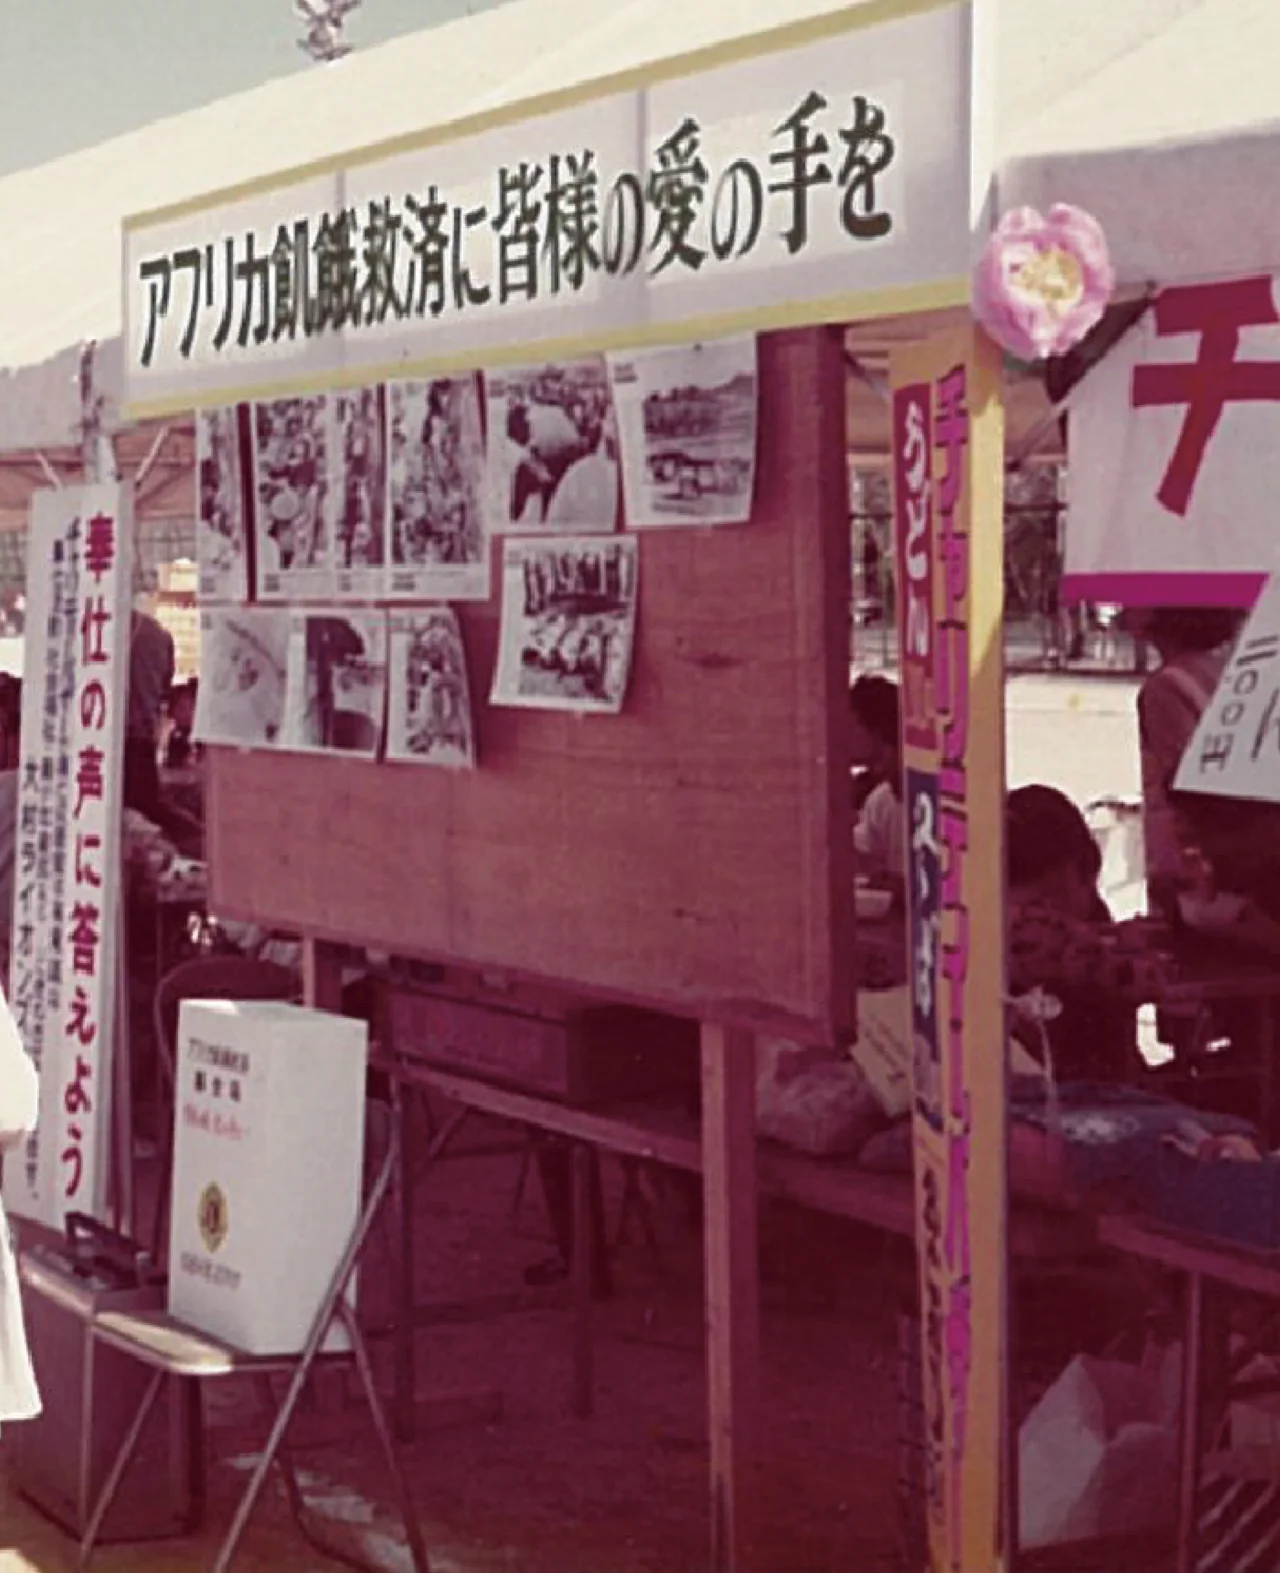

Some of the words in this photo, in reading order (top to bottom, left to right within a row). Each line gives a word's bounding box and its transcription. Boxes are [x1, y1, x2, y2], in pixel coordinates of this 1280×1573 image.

[136, 91, 896, 367] アフリカ飢餓救済に皆様の愛の手を
[1131, 274, 1280, 517] チ
[61, 511, 115, 1198] 奉仕の声に答えよう
